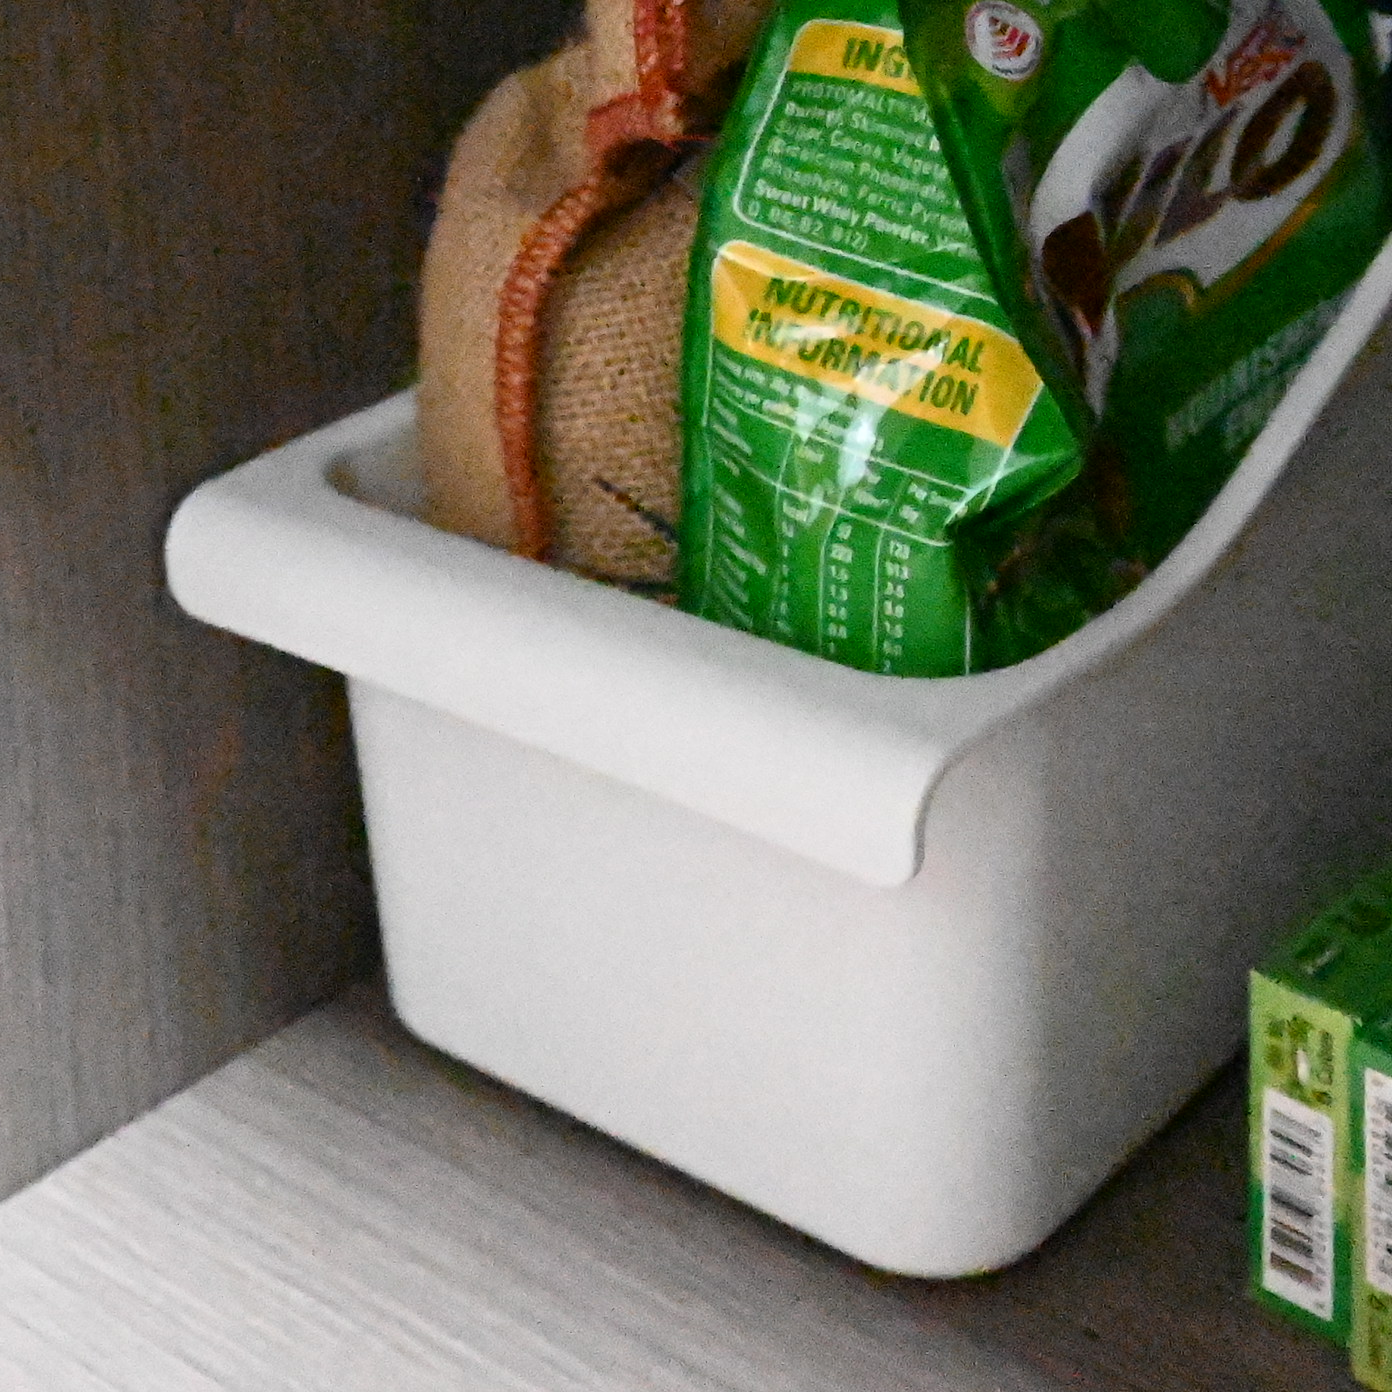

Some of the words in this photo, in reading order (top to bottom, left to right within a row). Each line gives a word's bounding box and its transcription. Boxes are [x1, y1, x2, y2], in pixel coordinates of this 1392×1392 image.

[843, 36, 916, 81] ING
[755, 179, 809, 209] Sweet
[813, 196, 859, 227] Whey
[763, 278, 985, 374] NUTRITIONAL
